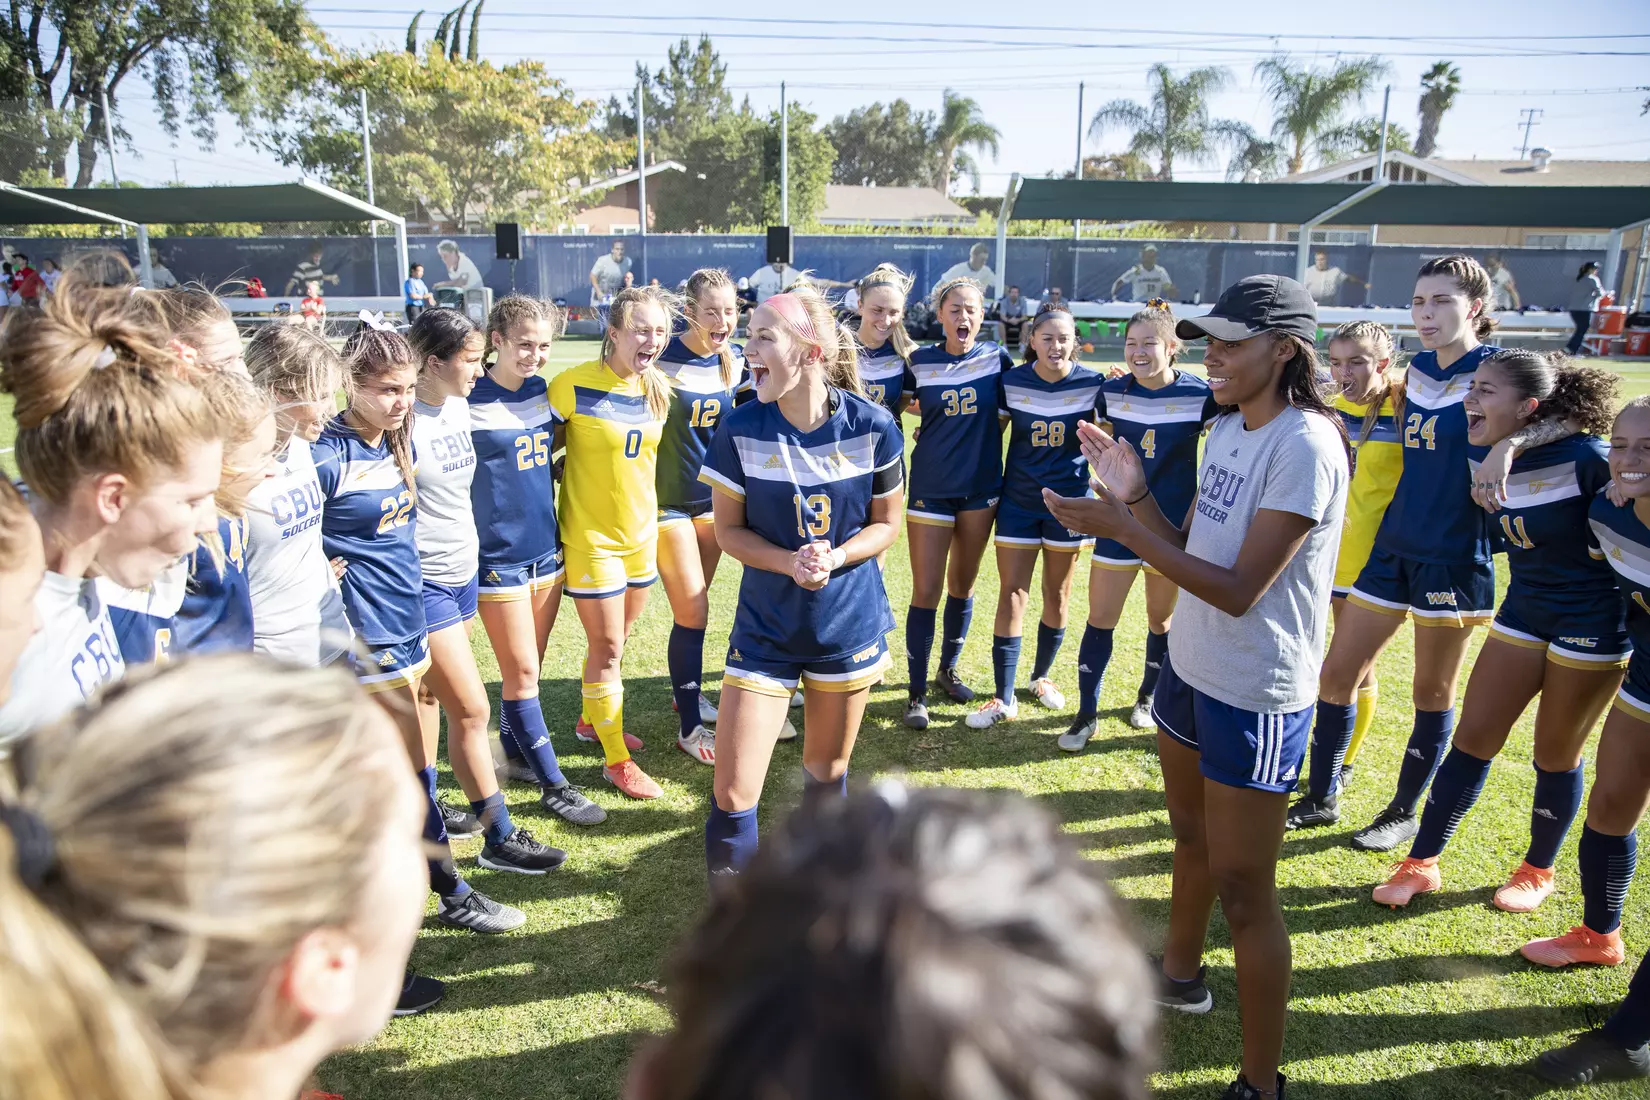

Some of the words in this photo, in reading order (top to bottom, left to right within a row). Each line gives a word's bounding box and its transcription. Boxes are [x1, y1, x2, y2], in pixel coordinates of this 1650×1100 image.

[688, 398, 721, 428] 12
[941, 387, 978, 417] 32
[430, 430, 473, 462] CBU
[623, 428, 644, 460] 0
[1031, 421, 1066, 447] 28
[1140, 428, 1156, 459] 4
[1404, 412, 1440, 451] 24
[442, 455, 475, 474] SOCCER
[514, 431, 550, 472] 25
[1200, 462, 1247, 511] CBU
[270, 479, 321, 528] CBU
[376, 489, 414, 535] 22
[793, 493, 832, 538] 13
[1197, 499, 1229, 525] SOCCER
[281, 513, 321, 540] SOCCER
[1499, 514, 1536, 549] 11
